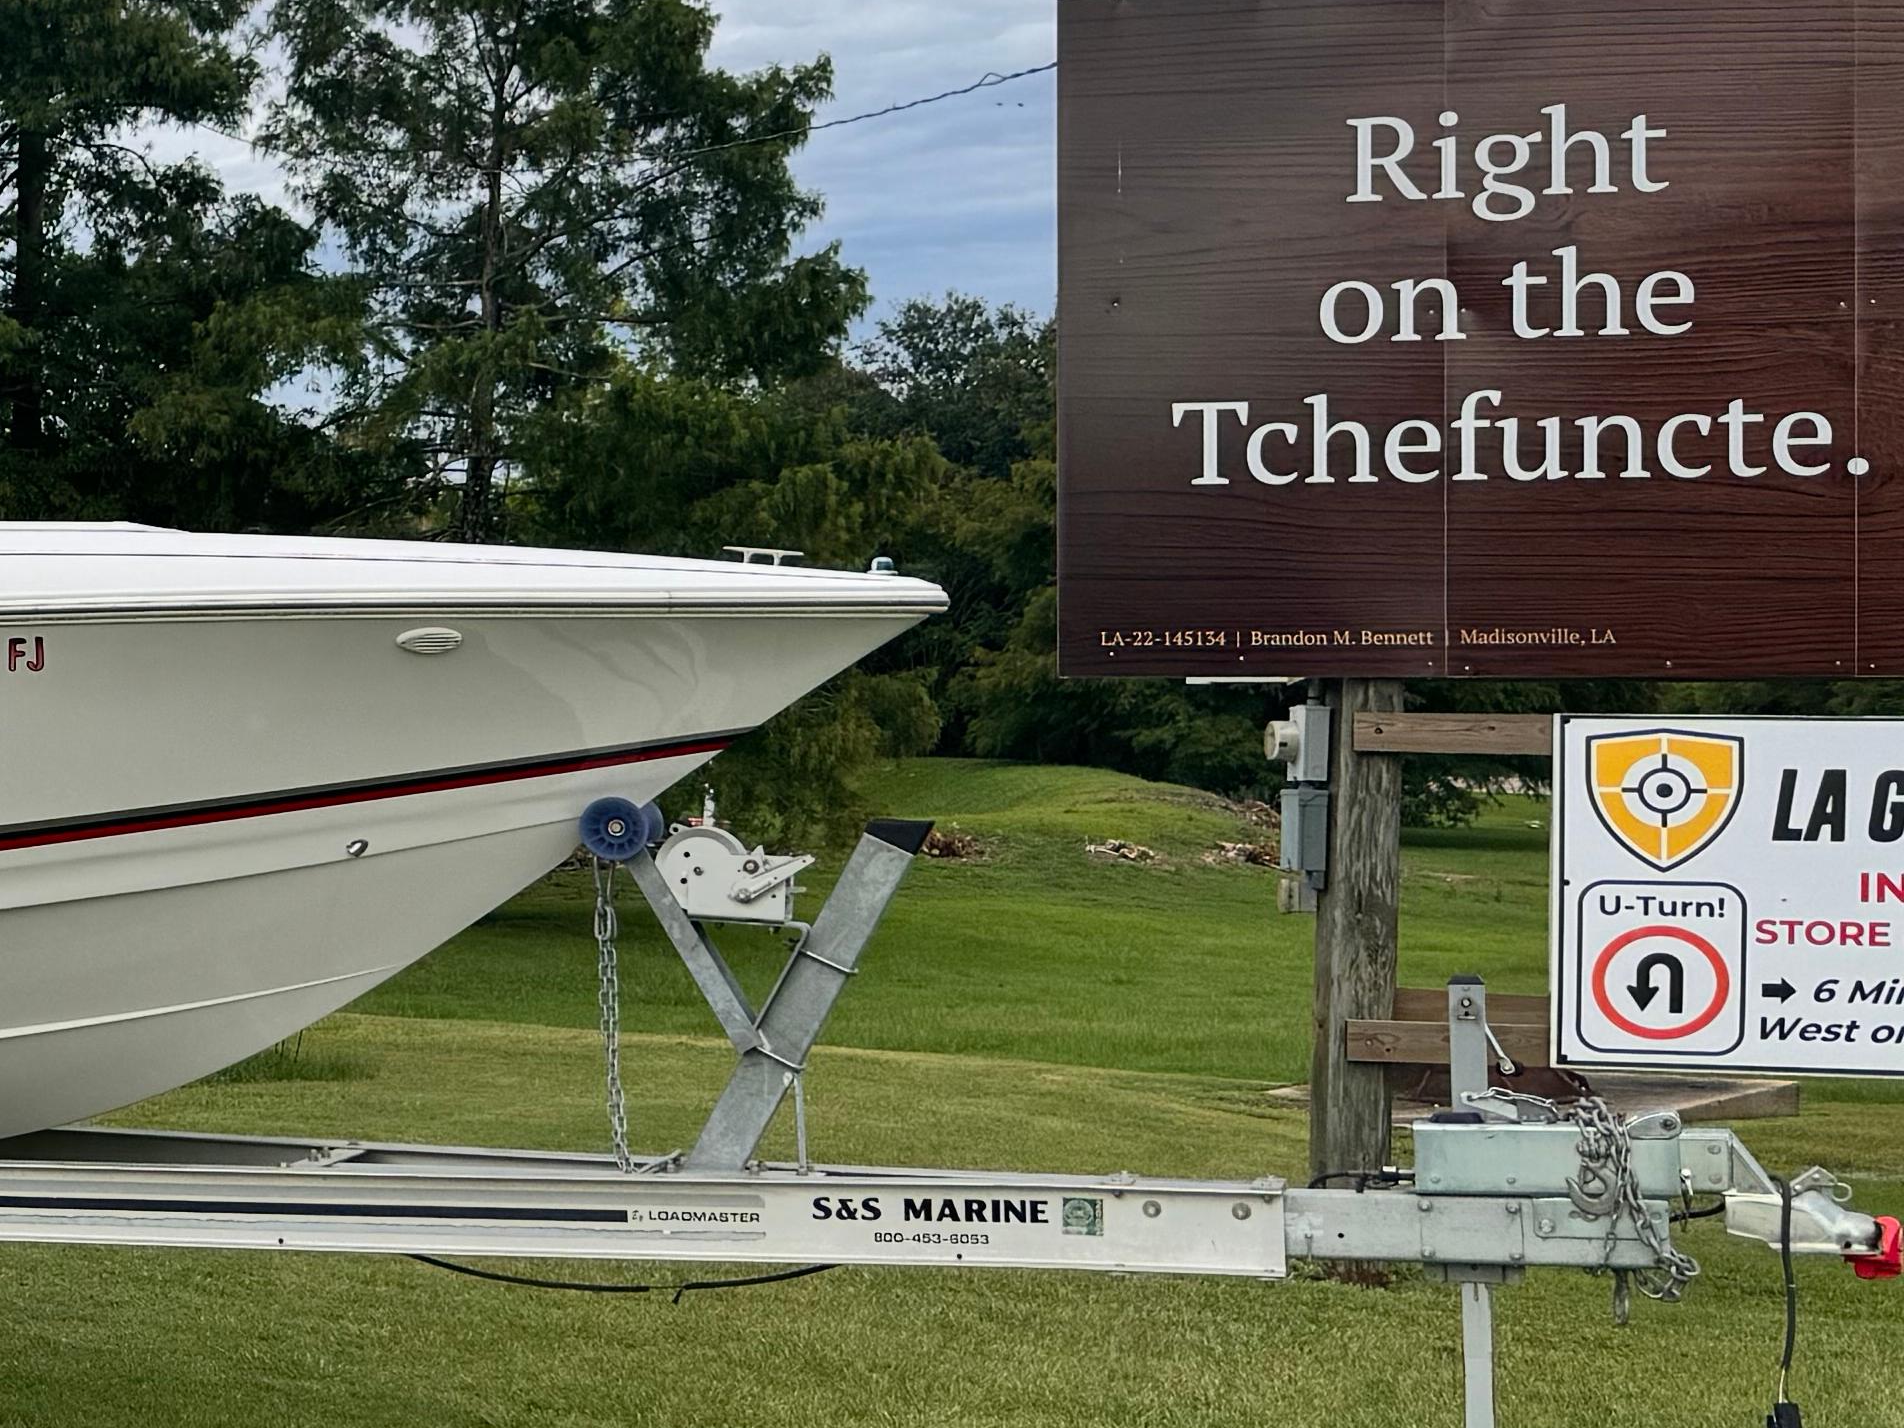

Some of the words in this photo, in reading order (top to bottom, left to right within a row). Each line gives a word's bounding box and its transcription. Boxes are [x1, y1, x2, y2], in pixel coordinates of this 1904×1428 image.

[1345, 103, 1670, 222] Right
[1319, 278, 1467, 344] on
[1501, 245, 1695, 339] the
[1171, 389, 1870, 485] Tchefuncte.
[1101, 630, 1226, 647] LA-22-145134
[1250, 630, 1328, 646] Brandon
[1333, 630, 1356, 646] M.
[1361, 630, 1434, 646] Bennett
[1460, 628, 1586, 647] Madisonville,
[1591, 628, 1617, 644] LA
[7, 637, 45, 672] FJ
[1771, 768, 1847, 842] LA
[1868, 769, 1904, 842] G
[1599, 895, 1725, 918] U-Turn!
[1755, 919, 1890, 947] STORE
[1813, 979, 1840, 1003] 6
[1760, 1016, 1860, 1043] West
[649, 1210, 760, 1223] LOADMASTER
[812, 1196, 882, 1221] S&S
[903, 1198, 1049, 1224] MARINE
